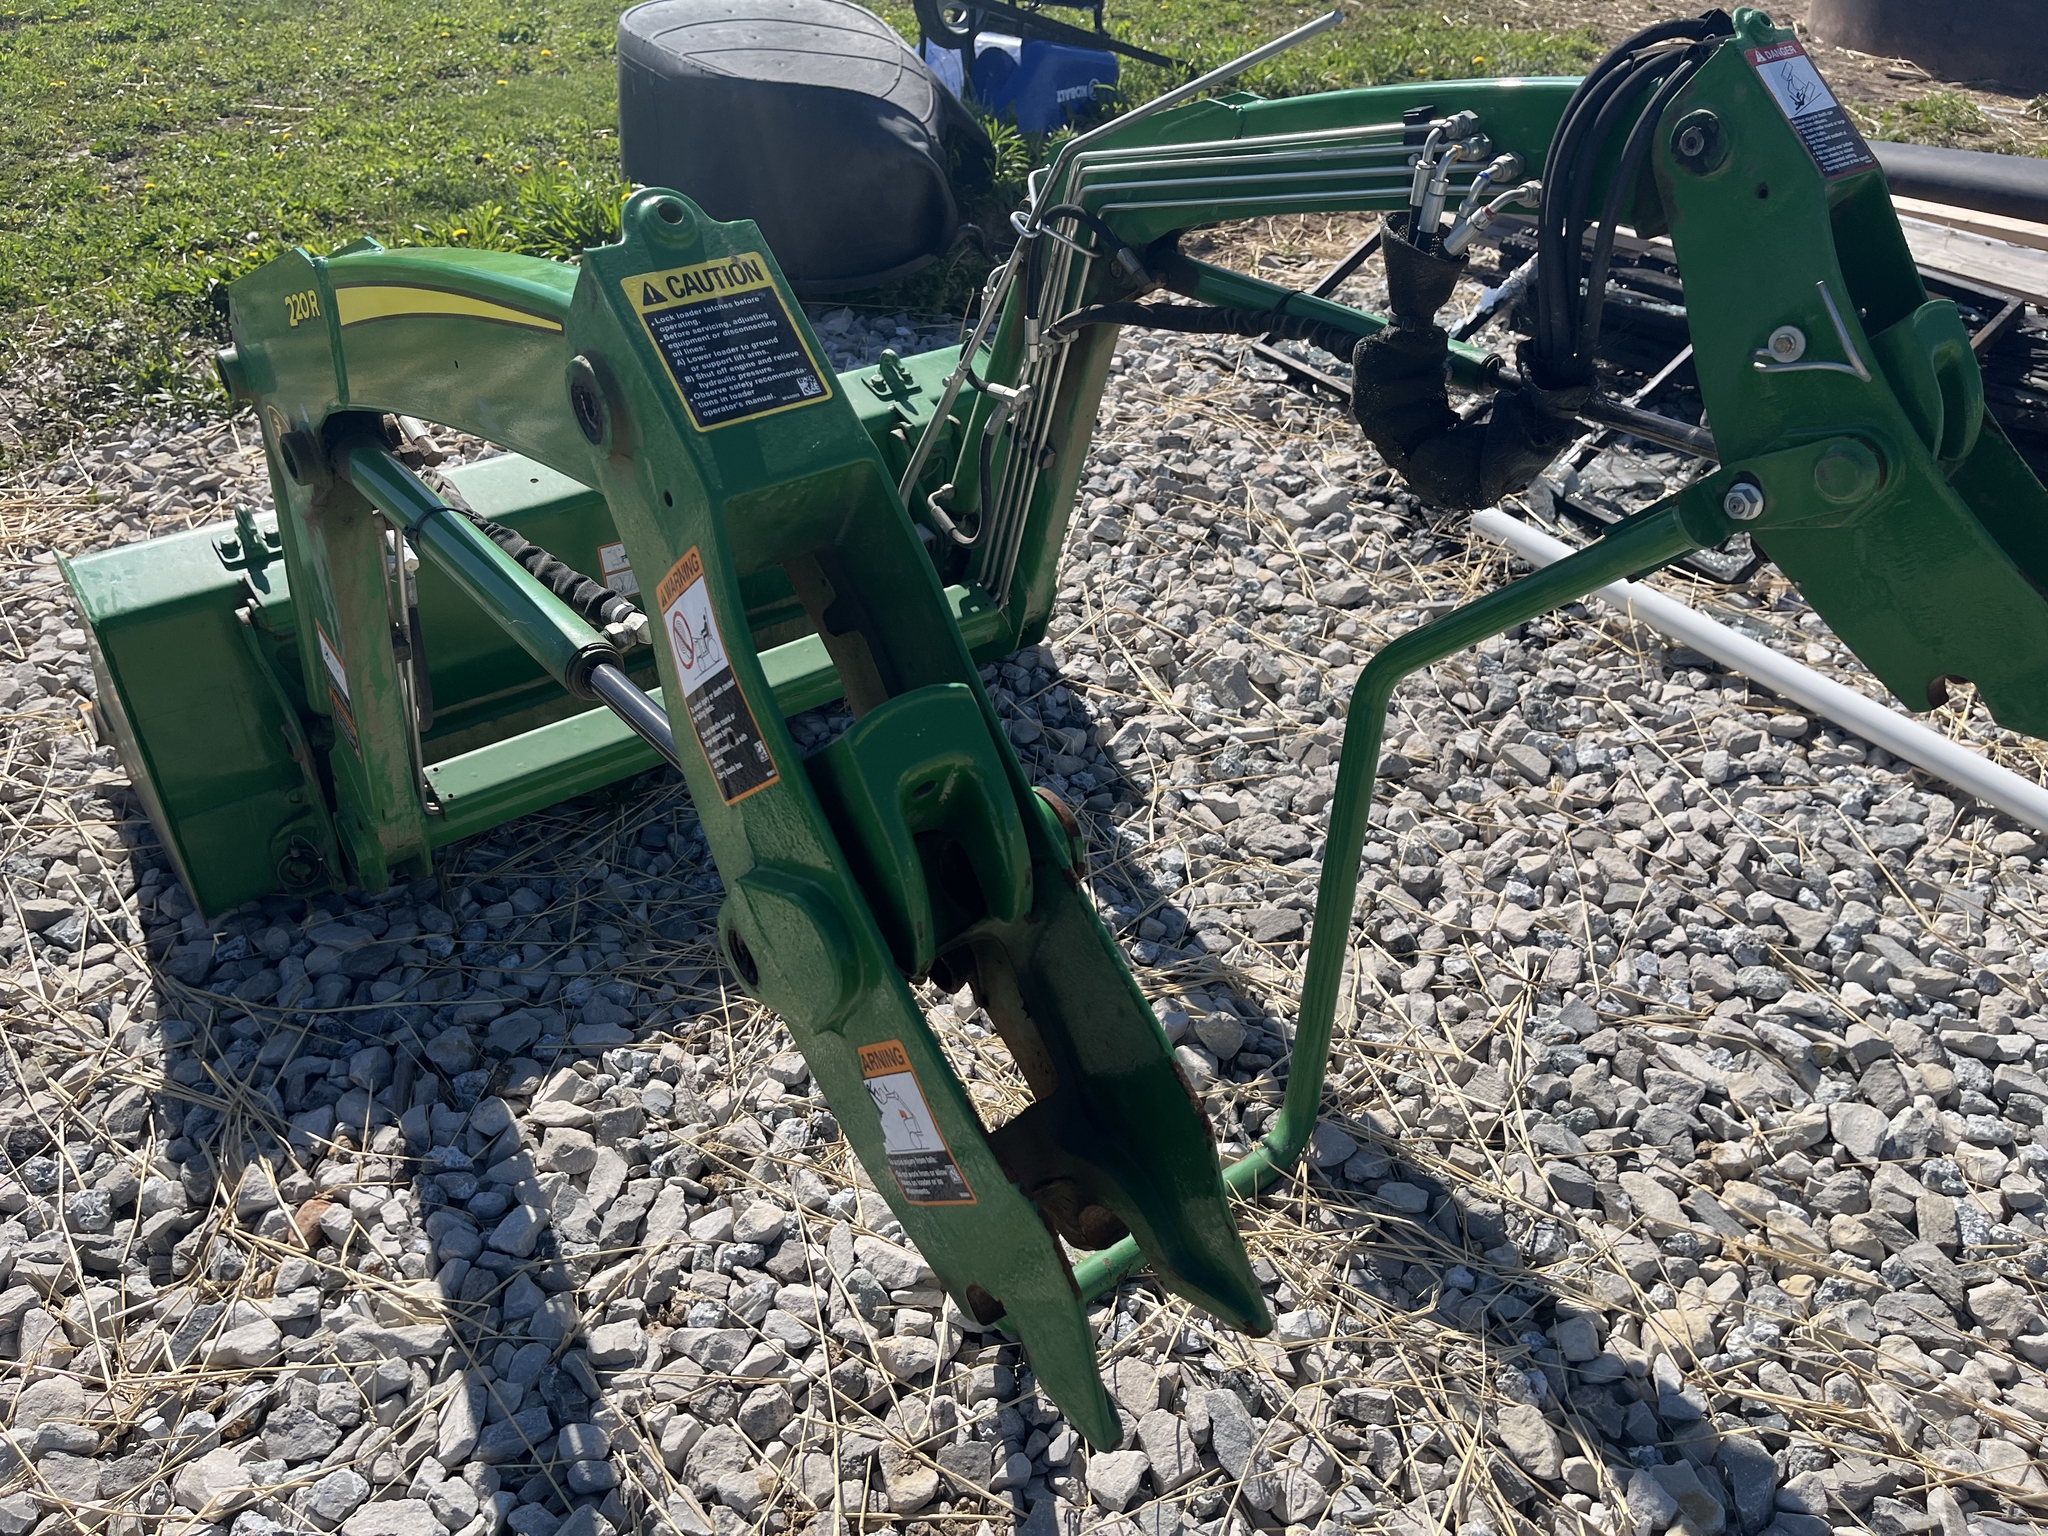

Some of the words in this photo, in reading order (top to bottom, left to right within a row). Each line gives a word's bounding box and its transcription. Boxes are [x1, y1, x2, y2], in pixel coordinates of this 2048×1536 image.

[1766, 45, 1796, 59] DANGER
[666, 259, 764, 298] CAUTION
[655, 315, 675, 324] Lock
[676, 310, 701, 319] loader
[704, 303, 733, 312] latches
[734, 297, 759, 306] before
[660, 320, 700, 332] operating.
[663, 331, 690, 340] Before
[693, 322, 731, 334] servicing,
[733, 313, 768, 324] adjusting
[668, 335, 710, 349] equipment
[723, 320, 777, 336] disconnecting
[684, 346, 706, 354] lines:
[687, 354, 711, 363] Lower
[713, 347, 738, 357] loader
[751, 337, 778, 349] ground
[702, 357, 733, 369] support
[747, 350, 769, 358] arms.
[696, 371, 715, 380] Shut
[717, 367, 727, 375] off
[730, 362, 755, 371] engine
[758, 357, 772, 365] and
[774, 351, 799, 361] relieve
[699, 376, 736, 388] hydraulic
[738, 367, 774, 380] pressure.
[694, 388, 727, 399] Observe
[729, 381, 753, 390] safety
[755, 368, 806, 384] recommenda-
[698, 399, 719, 408] tions
[729, 390, 754, 400] loader
[703, 402, 743, 416] operator's
[745, 394, 776, 405] manual.
[664, 552, 700, 600] WARNING
[862, 1047, 904, 1073] ARNING
